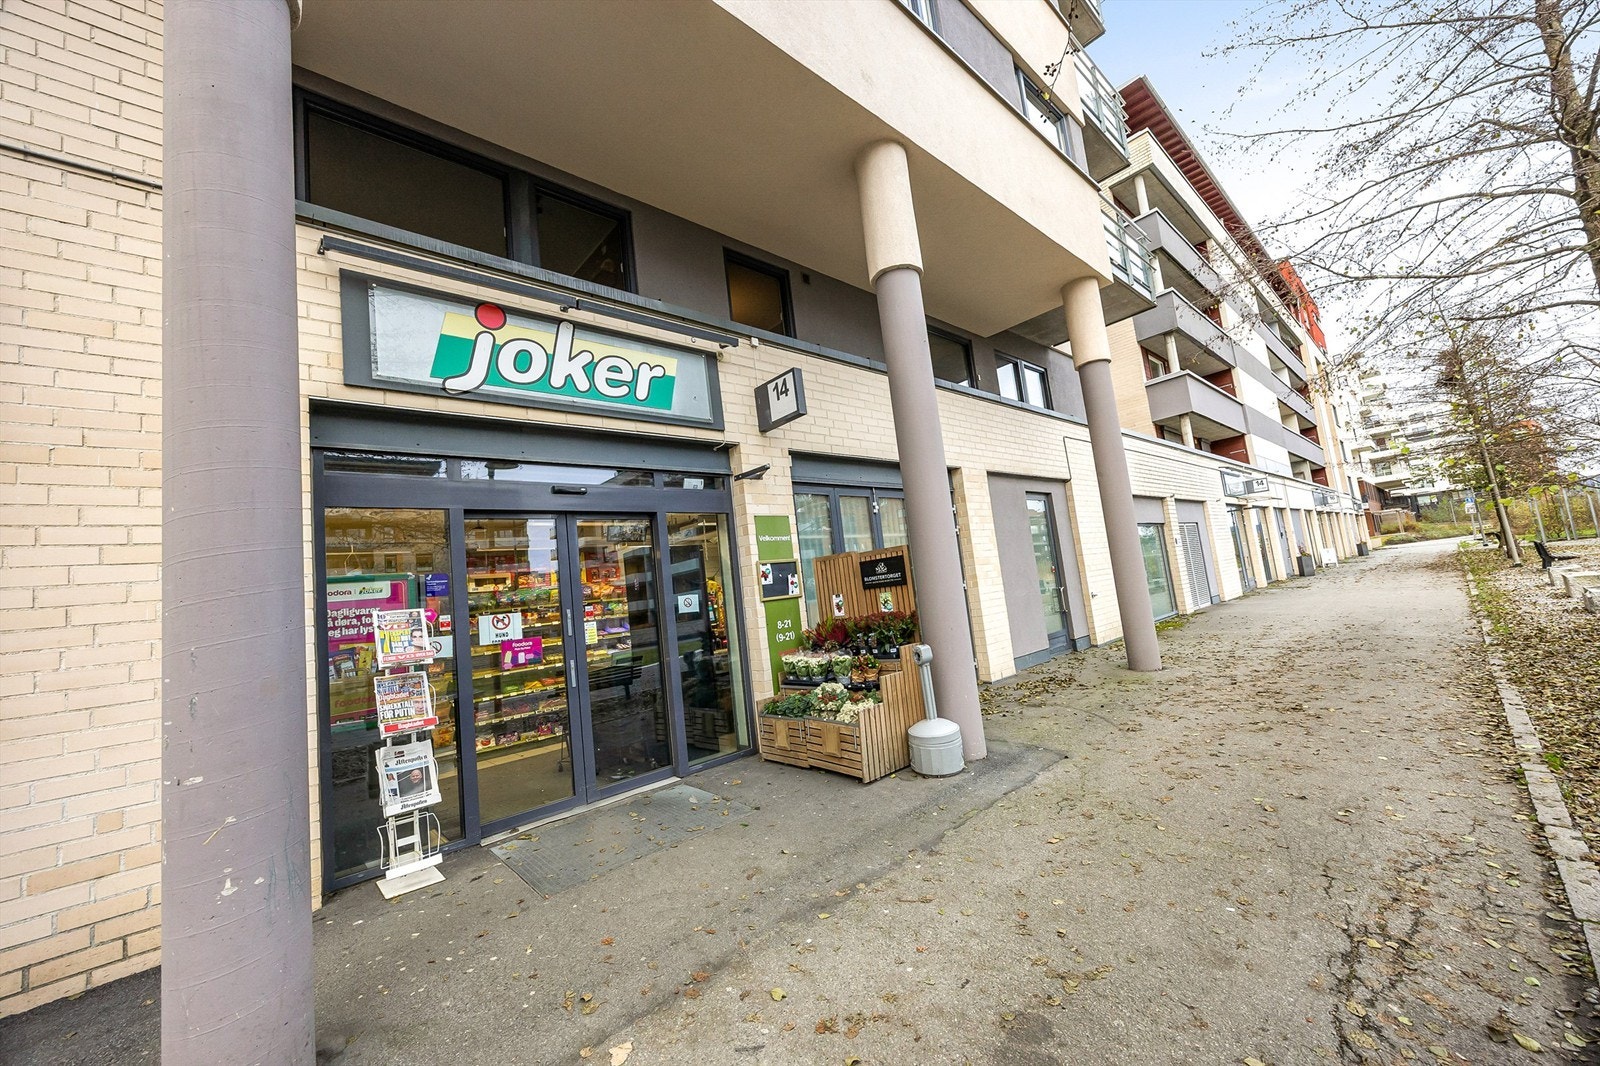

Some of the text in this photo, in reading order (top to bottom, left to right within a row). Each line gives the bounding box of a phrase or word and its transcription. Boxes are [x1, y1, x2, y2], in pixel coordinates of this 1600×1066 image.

[442, 302, 666, 401] joker
[772, 377, 789, 401] 14
[864, 572, 901, 582] BLOMSTERTORGET
[327, 617, 334, 627] å
[361, 615, 374, 624] fo
[777, 620, 792, 629] 8-21
[328, 625, 374, 638] eg har lys
[776, 631, 795, 642] (9-21)
[394, 707, 416, 718] PUTIN
